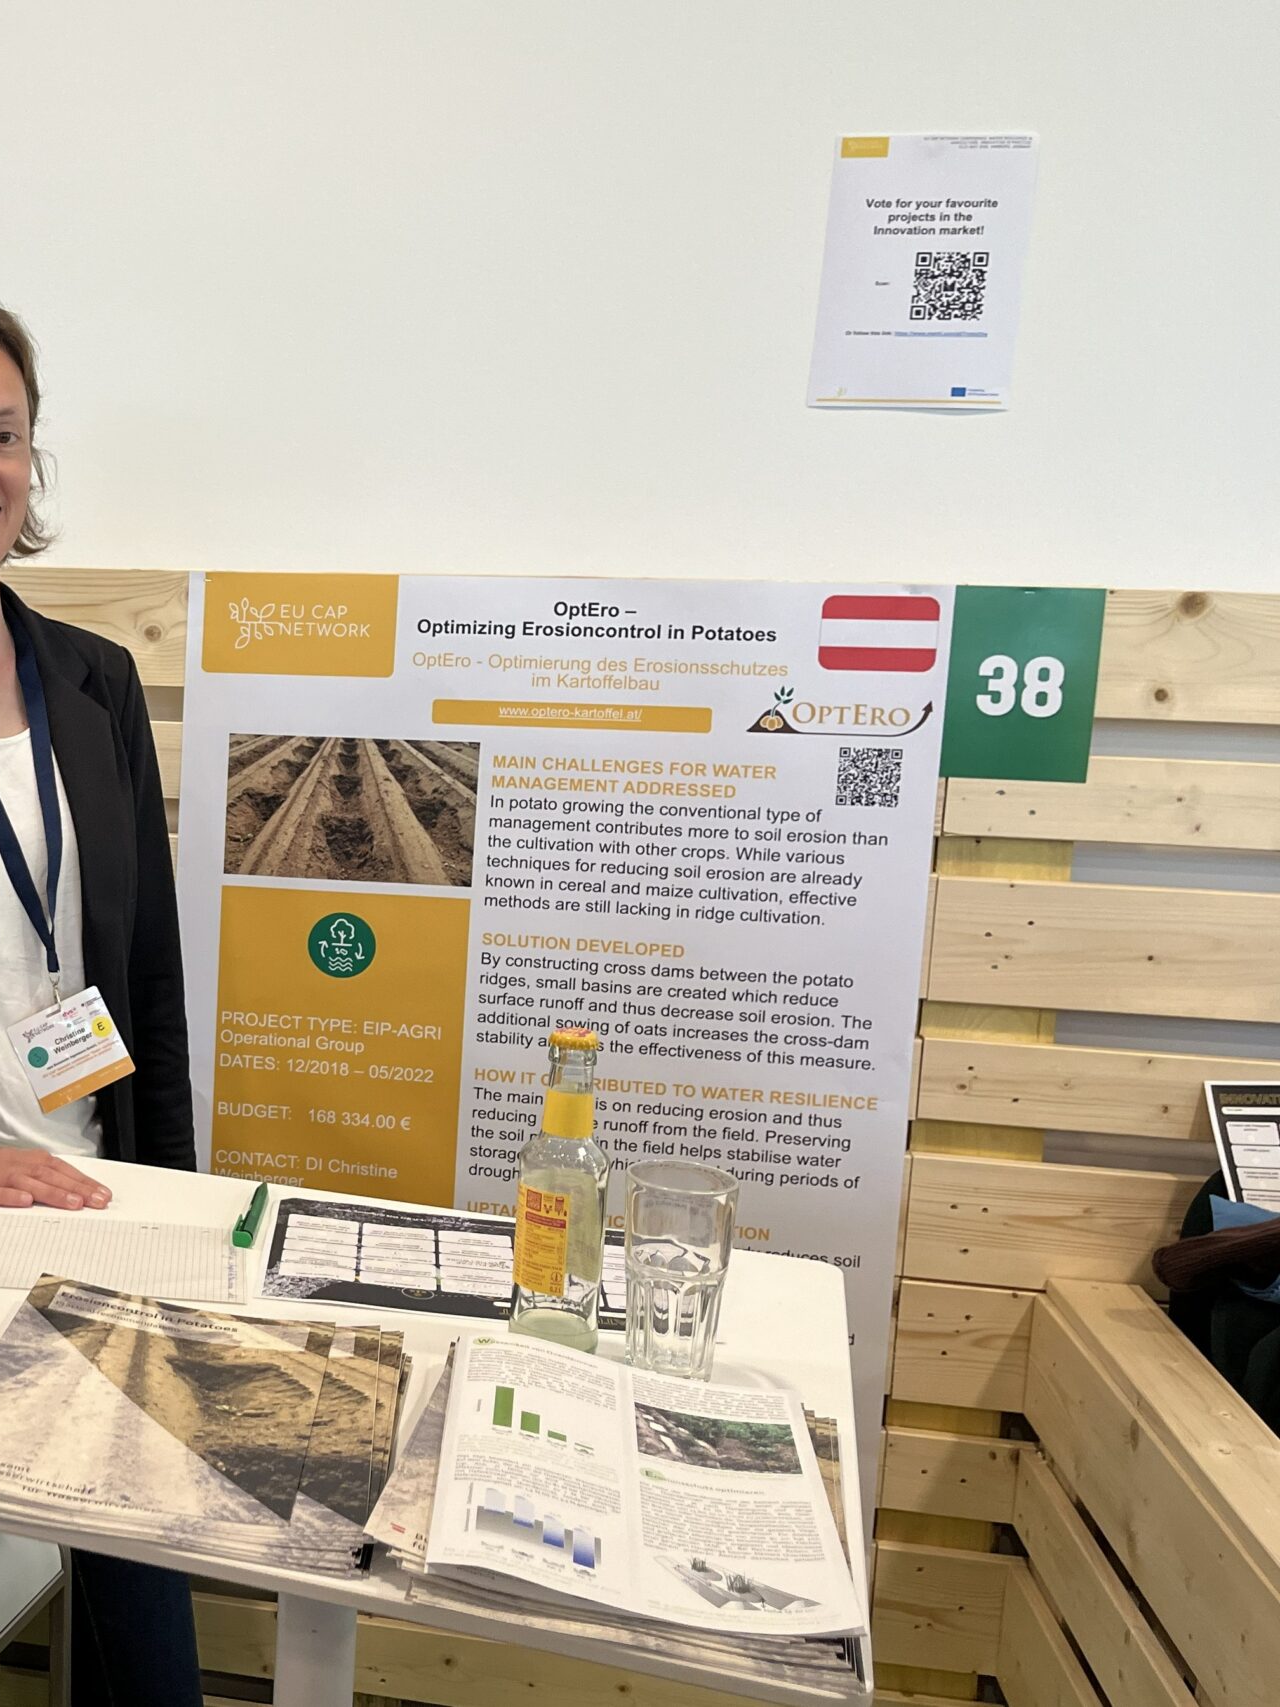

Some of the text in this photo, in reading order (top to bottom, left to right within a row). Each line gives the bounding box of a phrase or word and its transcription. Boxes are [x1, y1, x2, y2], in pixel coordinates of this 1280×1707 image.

[865, 198, 998, 210] Vote for your favourite
[873, 225, 984, 235] Innovation market!
[887, 211, 973, 224] projects in the
[280, 603, 347, 619] EU CAP
[553, 601, 619, 620] OptEro
[279, 621, 370, 638] NETWORK
[417, 618, 776, 642] Optimizing Erosioncontrol in Potatoes
[412, 651, 788, 676] OptEro Optimierung des Erosionsschutzes
[531, 672, 660, 691] im Kartoffelbau
[976, 654, 1065, 718] 38
[492, 754, 776, 779] MAIN CHALLENGES FOR WATER
[491, 774, 736, 798] MANAGEMENT ADDRESSED
[490, 794, 822, 824] In potato growing the conventional type of
[484, 894, 824, 925] methods are still lacking in ridge cultivation.
[482, 932, 684, 958] SOLUTION DEVELOPED
[54, 1027, 86, 1045] Christine
[221, 1010, 441, 1040] PROJECT TYPE: EIP-AGRI
[220, 1029, 364, 1055] Operational Group
[220, 1053, 434, 1083] DATES: 12/2018 05/2022
[218, 1101, 411, 1131] BUDGET: 168 334.00 €
[215, 1149, 398, 1179] CONTACT: DI Christine
